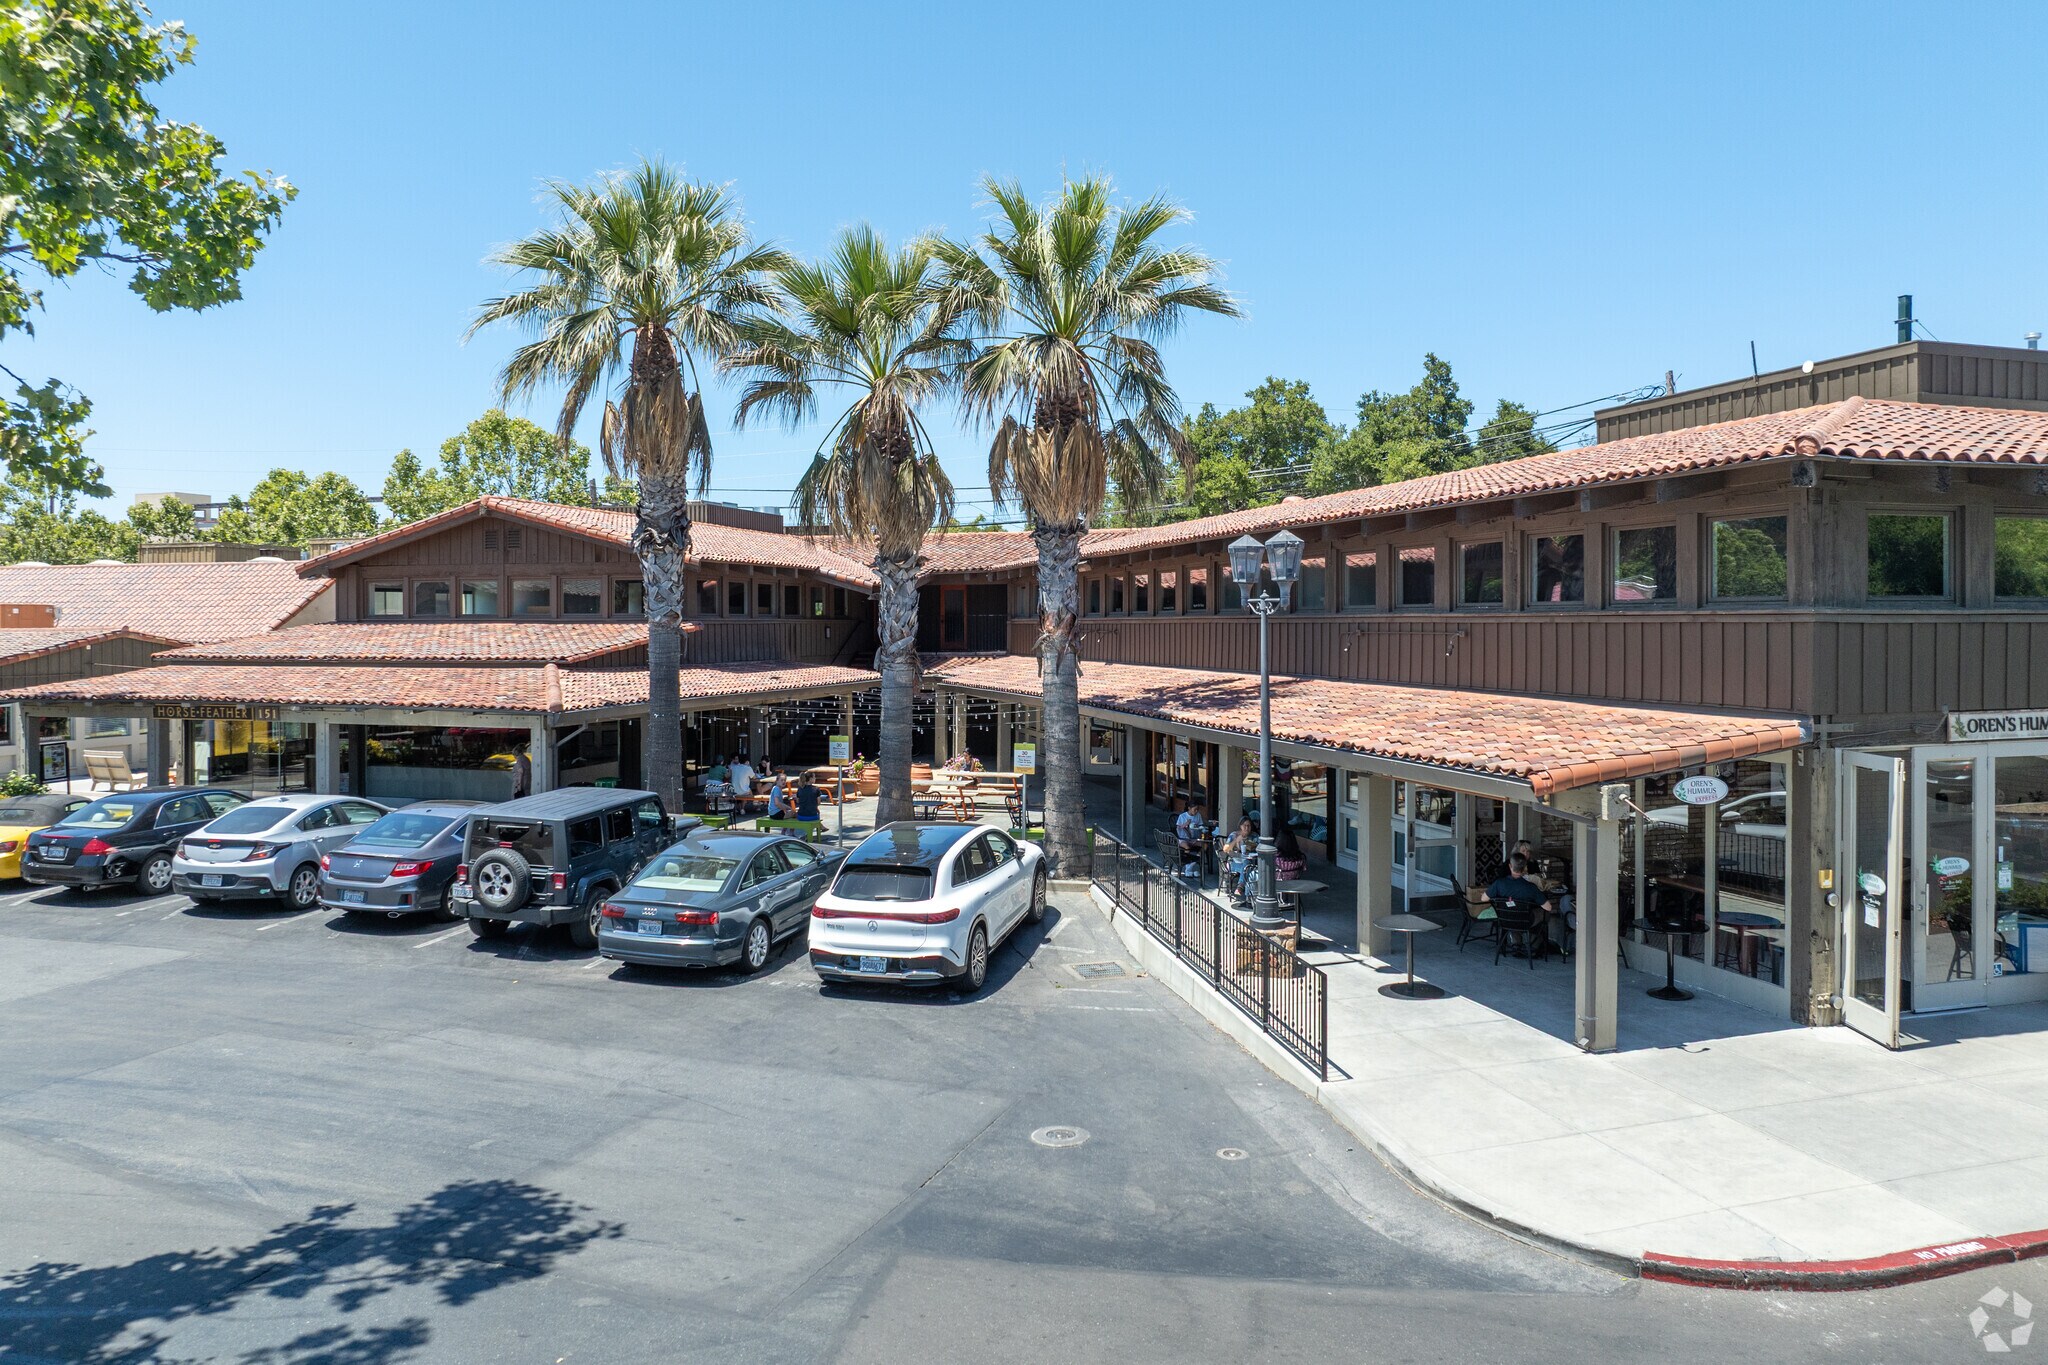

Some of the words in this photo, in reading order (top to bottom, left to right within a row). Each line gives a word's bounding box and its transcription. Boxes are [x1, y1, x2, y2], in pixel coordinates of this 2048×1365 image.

[258, 708, 277, 719] 151
[1967, 716, 2017, 733] OREN'S
[2019, 716, 2048, 731] HUM
[1690, 780, 1713, 788] OREN'S
[1687, 787, 1717, 795] HUMMUS
[1695, 794, 1718, 803] EXPRESS
[1913, 1250, 1938, 1260] NO
[1933, 1241, 1987, 1257] PARKING
